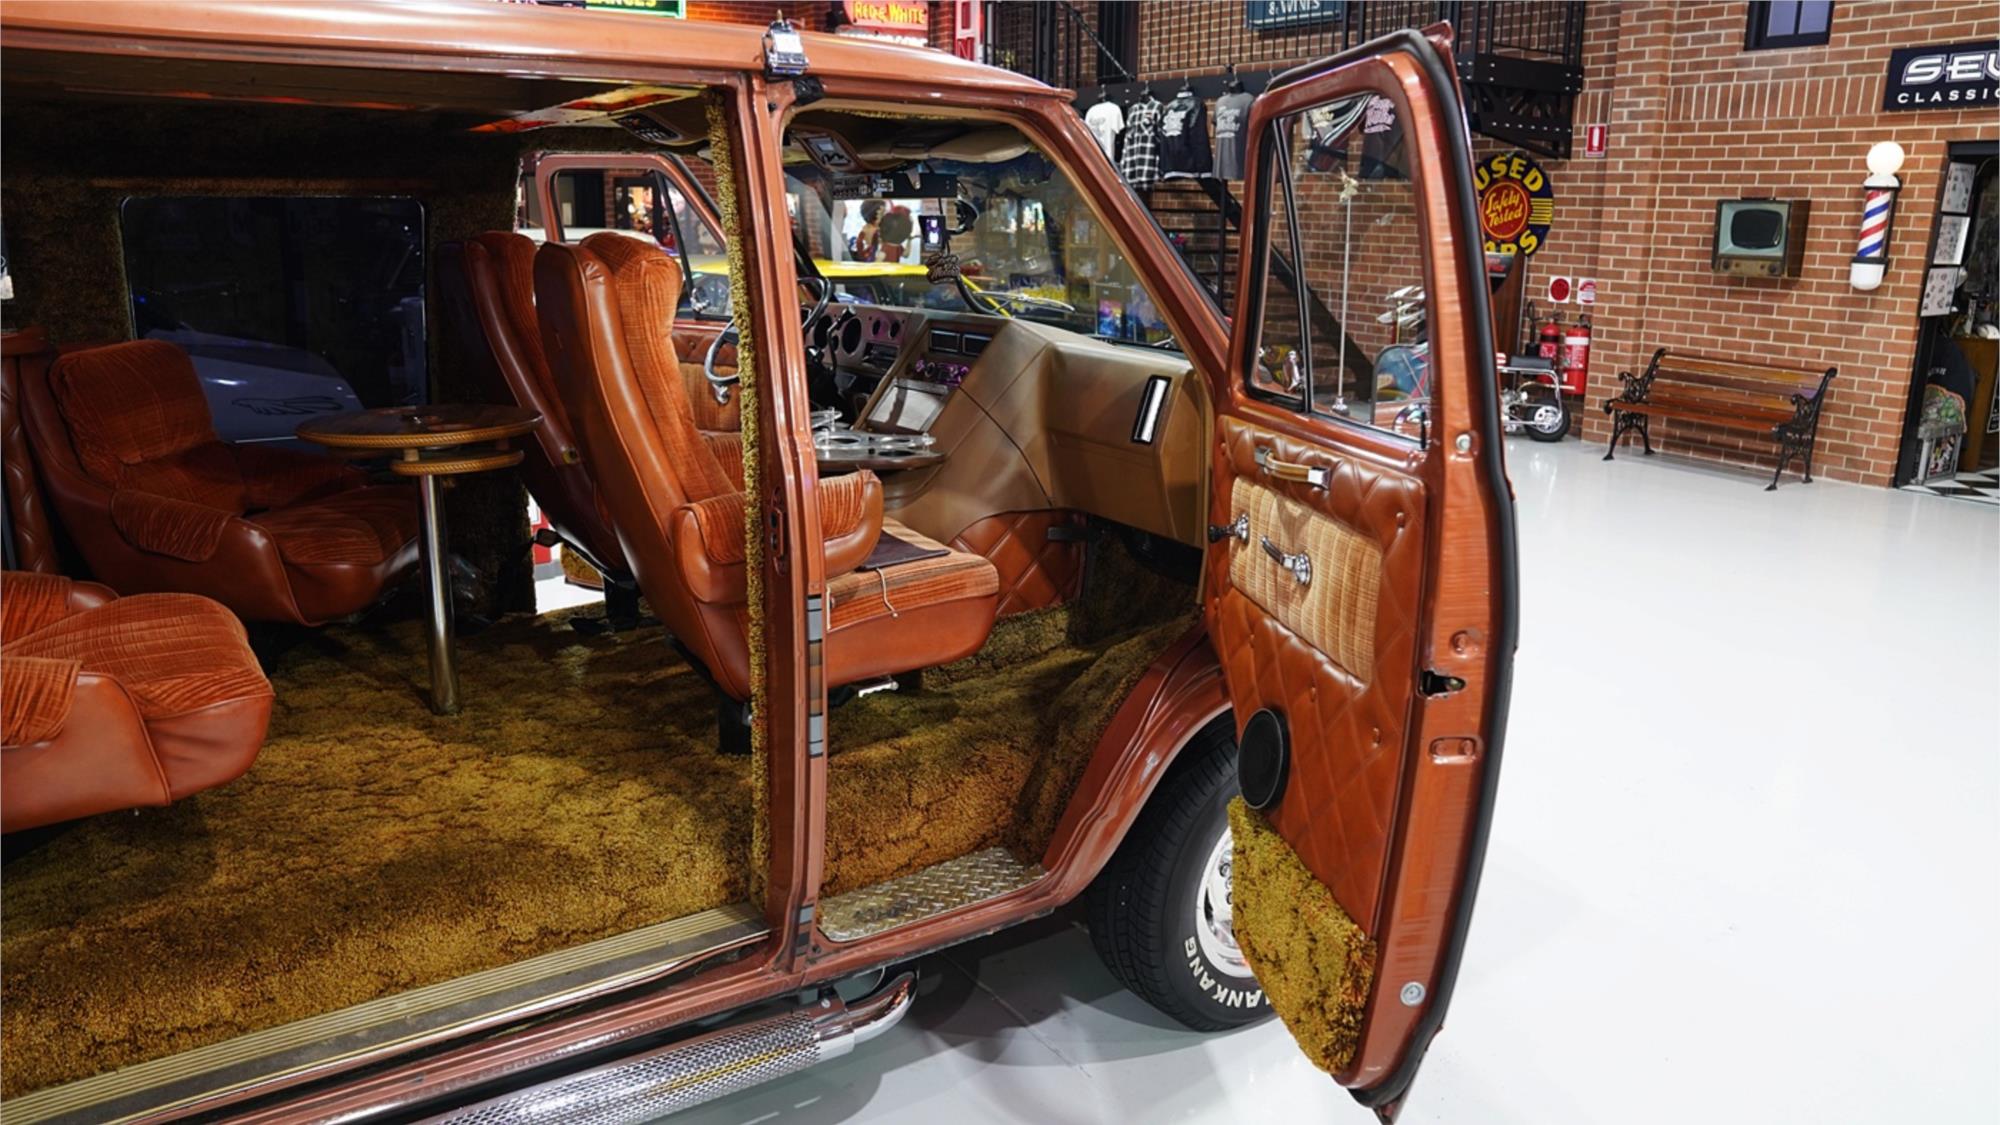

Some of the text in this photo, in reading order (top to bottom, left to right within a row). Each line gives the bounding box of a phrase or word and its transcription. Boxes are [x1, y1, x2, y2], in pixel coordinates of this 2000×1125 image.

[889, 4, 926, 24] WHITE
[1475, 156, 1544, 191] USED
[1486, 190, 1520, 214] Safety
[1488, 204, 1523, 227] Tested
[1485, 230, 1538, 255] ARS
